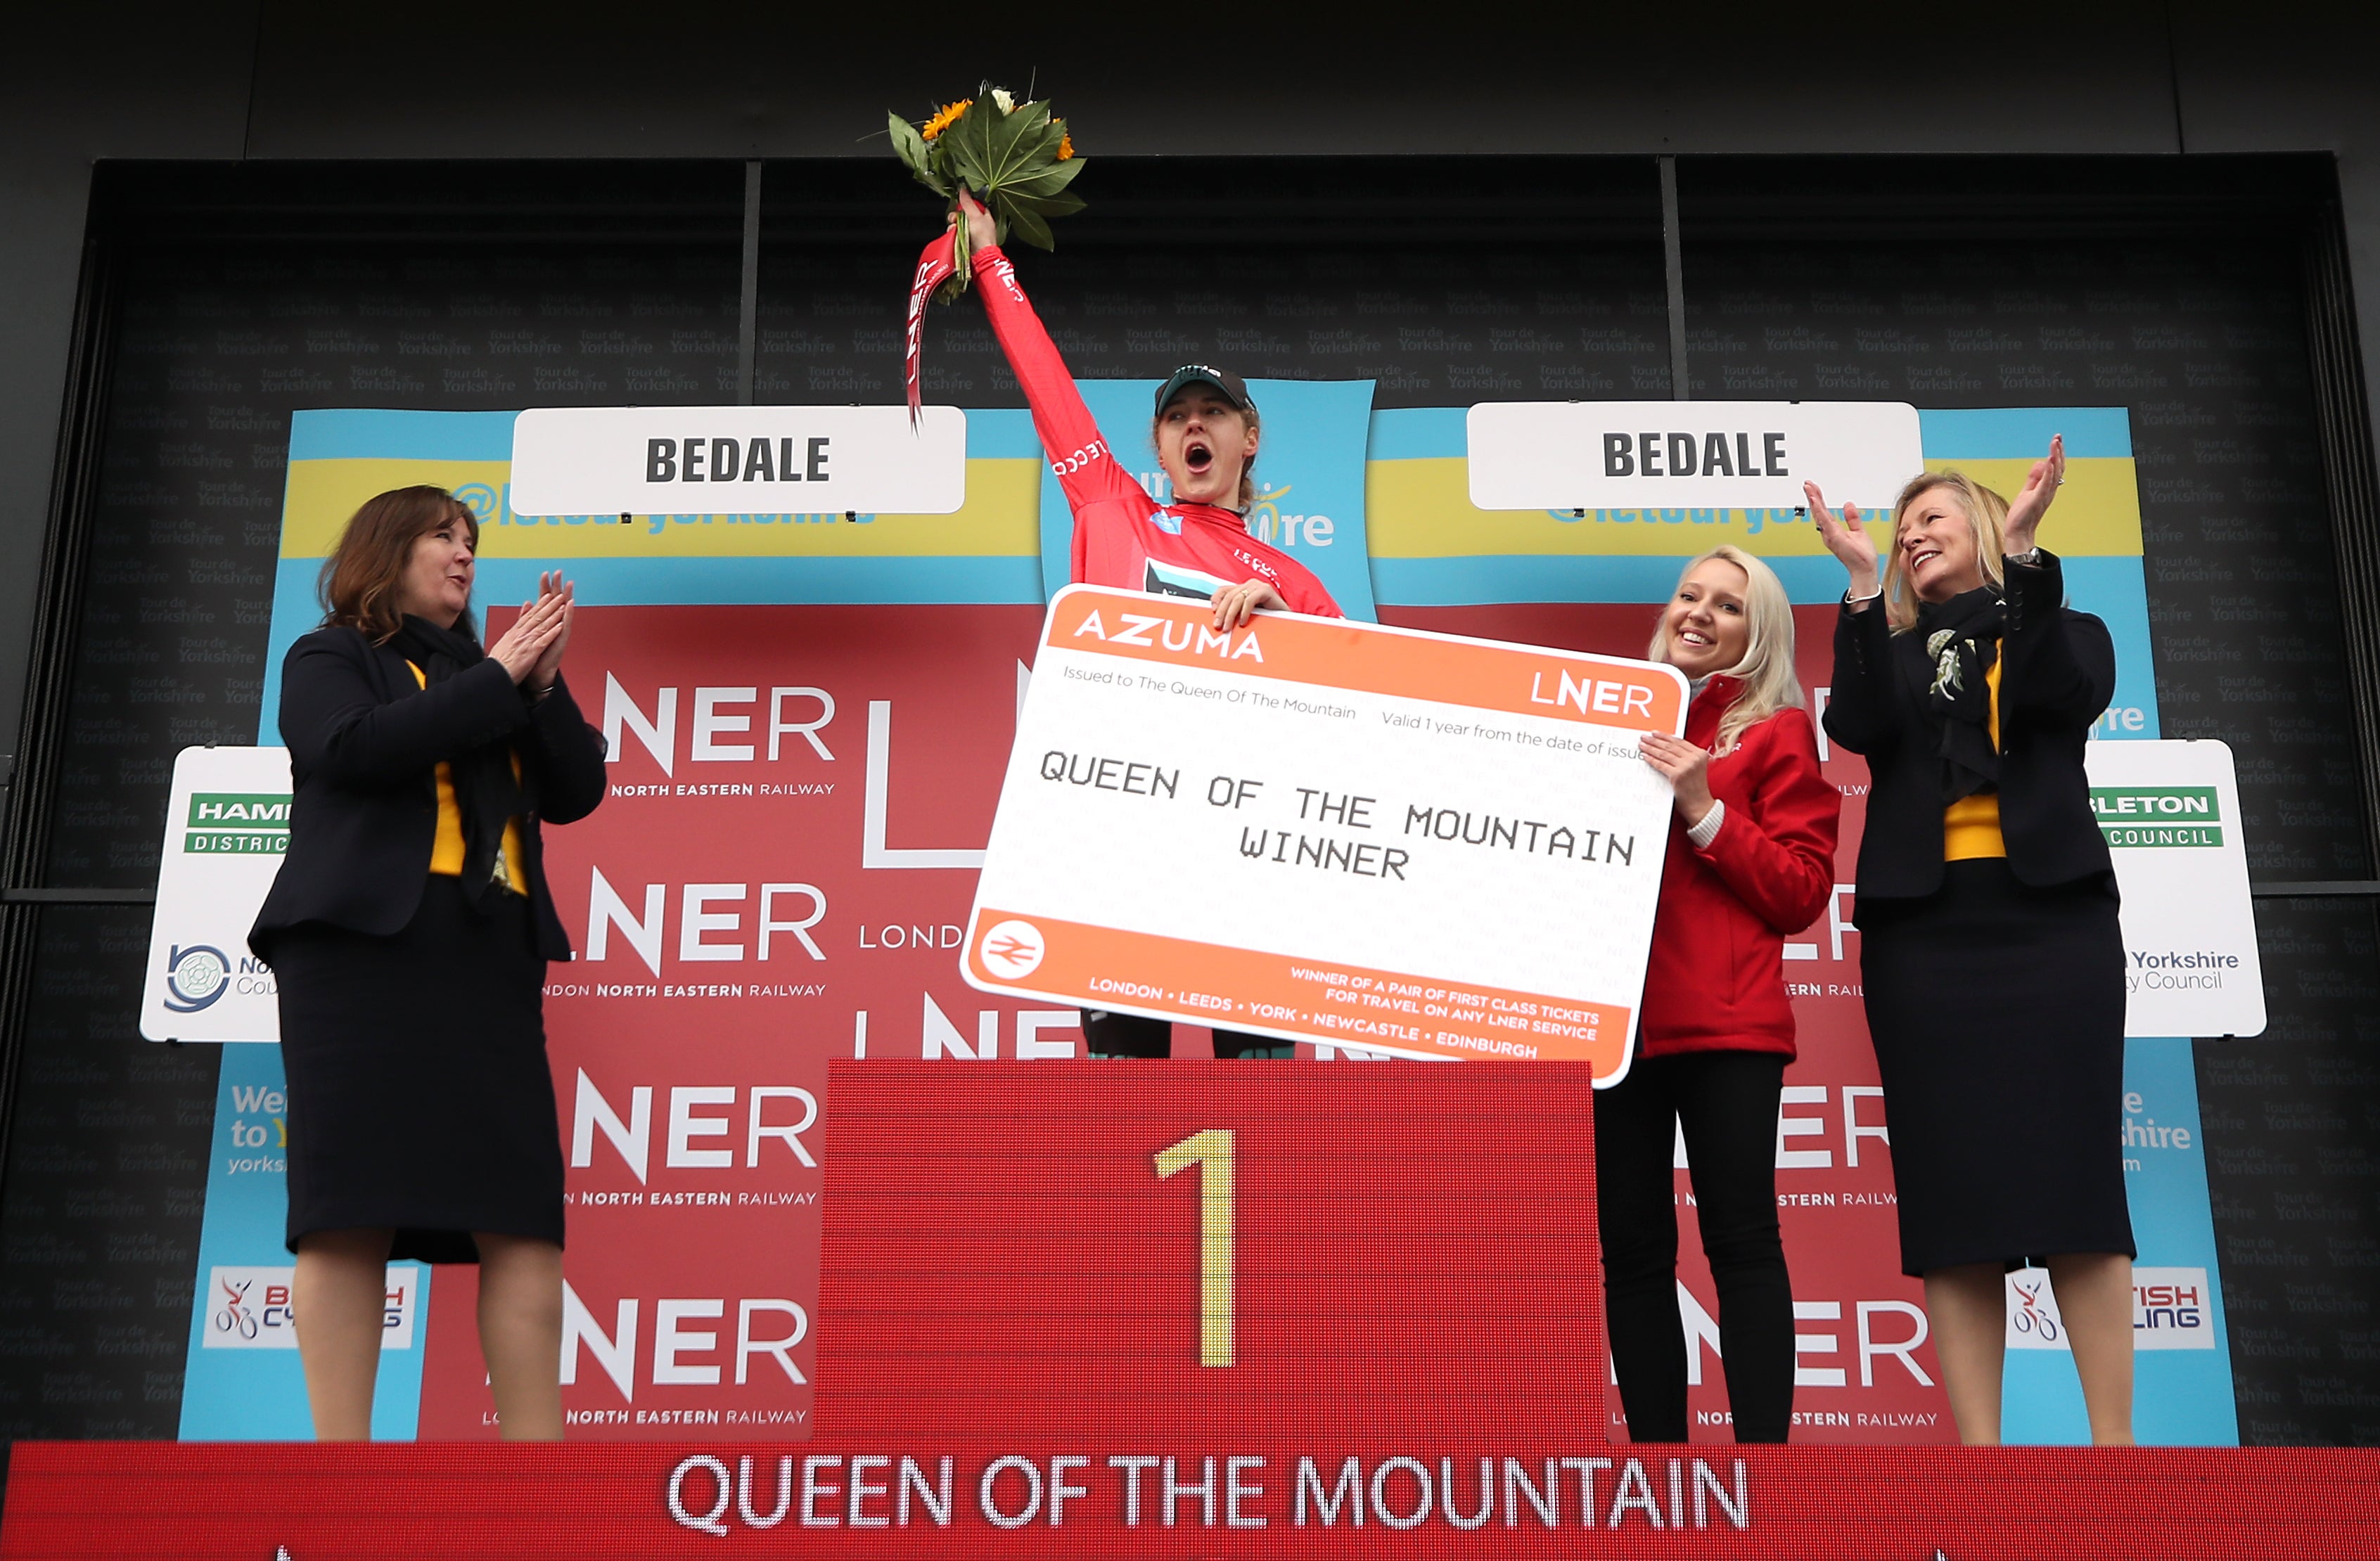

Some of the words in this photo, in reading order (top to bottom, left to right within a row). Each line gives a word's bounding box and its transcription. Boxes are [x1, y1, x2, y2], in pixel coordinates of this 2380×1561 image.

[907, 259, 939, 385] LNER
[306, 338, 379, 354] Yorkshire
[397, 339, 471, 356] Yorkshire
[488, 338, 562, 355] Yorkshire
[579, 338, 653, 355] Yorkshire
[762, 338, 835, 355] Yorkshire
[1125, 336, 1199, 354] Yorkshire
[1307, 337, 1381, 354] Yorkshire
[1397, 336, 1472, 354] Yorkshire
[1581, 336, 1655, 353] Yorkshire
[1764, 335, 1838, 352] Yorkshire
[1855, 336, 1930, 354] Yorkshire
[2040, 335, 2115, 352] Yorkshire
[809, 375, 881, 392] Yorkshire
[1448, 373, 1522, 391] Yorkshire
[646, 437, 831, 483] BEDALE
[1602, 432, 1788, 477] BEDALE
[1074, 608, 1265, 663] AZUMA
[1063, 665, 1113, 685] Issued
[1117, 673, 1133, 687] to
[1138, 675, 1167, 693] The
[1171, 681, 1222, 700] Queen
[1227, 689, 1248, 704] Of
[1251, 692, 1279, 709] The
[1284, 698, 1357, 720] Mountain
[1530, 668, 1653, 718] LNER
[604, 669, 837, 779] NER
[1381, 711, 1420, 730] Valid
[1425, 717, 1431, 731] 1
[1434, 721, 1470, 738] year
[1474, 724, 1512, 743] from
[1516, 730, 1542, 746] the
[1546, 734, 1583, 752] date
[1587, 740, 1605, 755] of
[610, 783, 670, 797] NORTH
[676, 783, 753, 797] EASTERN
[759, 783, 836, 796] RAILWAY
[1040, 750, 1180, 799] QUEEN
[1207, 775, 1264, 810] OF
[1296, 787, 1377, 829] THE
[1404, 804, 1635, 866] MOUNTAIN
[193, 835, 288, 852] DISTRIC
[2110, 829, 2213, 845] COUNCIL
[1239, 826, 1410, 881] WINNER
[570, 864, 828, 979] NER
[859, 925, 963, 949] LOND
[2131, 951, 2239, 969] Yorkshire
[2145, 971, 2222, 990] Council
[542, 984, 590, 997] NDON
[596, 982, 658, 998] NORTH
[663, 982, 743, 998] EASTERN
[749, 983, 827, 997] RAILWAY
[1291, 966, 1348, 987] WINNER
[1351, 976, 1372, 990] OF
[1374, 980, 1386, 992] A
[1388, 982, 1422, 998] PAIR
[1425, 987, 1445, 1001] OF
[1448, 991, 1488, 1008] FIRST
[1491, 997, 1537, 1015] CLASS
[1542, 1004, 1600, 1026] TICKETS
[1829, 984, 1864, 996] RAIL
[1089, 976, 1164, 1000] LONDON
[1179, 991, 1233, 1012] LEEDS
[1250, 1001, 1298, 1022] YORK
[1313, 1013, 1420, 1042] NEWCASTLE
[1436, 1032, 1538, 1060] EDINBURGH
[1325, 988, 1358, 1004] FOR
[1362, 993, 1420, 1014] TRAVEL
[1424, 1003, 1448, 1018] ON
[1451, 1008, 1485, 1024] ANY
[1488, 1013, 1528, 1032] LNER
[1532, 1020, 1598, 1041] SERVICE
[231, 1119, 267, 1148] to
[570, 1066, 819, 1187] NER
[581, 1190, 644, 1206] NORTH
[649, 1190, 731, 1206] EASTERN
[737, 1191, 818, 1205] RAILWAY
[1777, 1191, 1836, 1207] STERN
[1843, 1191, 1898, 1206] RAILW
[1153, 1127, 1236, 1368] 1
[2132, 1285, 2199, 1306] ISH
[558, 1278, 809, 1405] NER
[565, 1409, 629, 1425] NORTH
[635, 1409, 719, 1425] EASTERN
[725, 1409, 807, 1425] RAILWAY
[1696, 1410, 1734, 1426] NOR
[1791, 1411, 1850, 1427] STERN
[1857, 1411, 1939, 1427] RAILWAY
[665, 1453, 954, 1538] QUEEN
[978, 1453, 1092, 1530] OF
[1108, 1453, 1268, 1530] THE
[1293, 1455, 1751, 1532] MOUNTAIN
